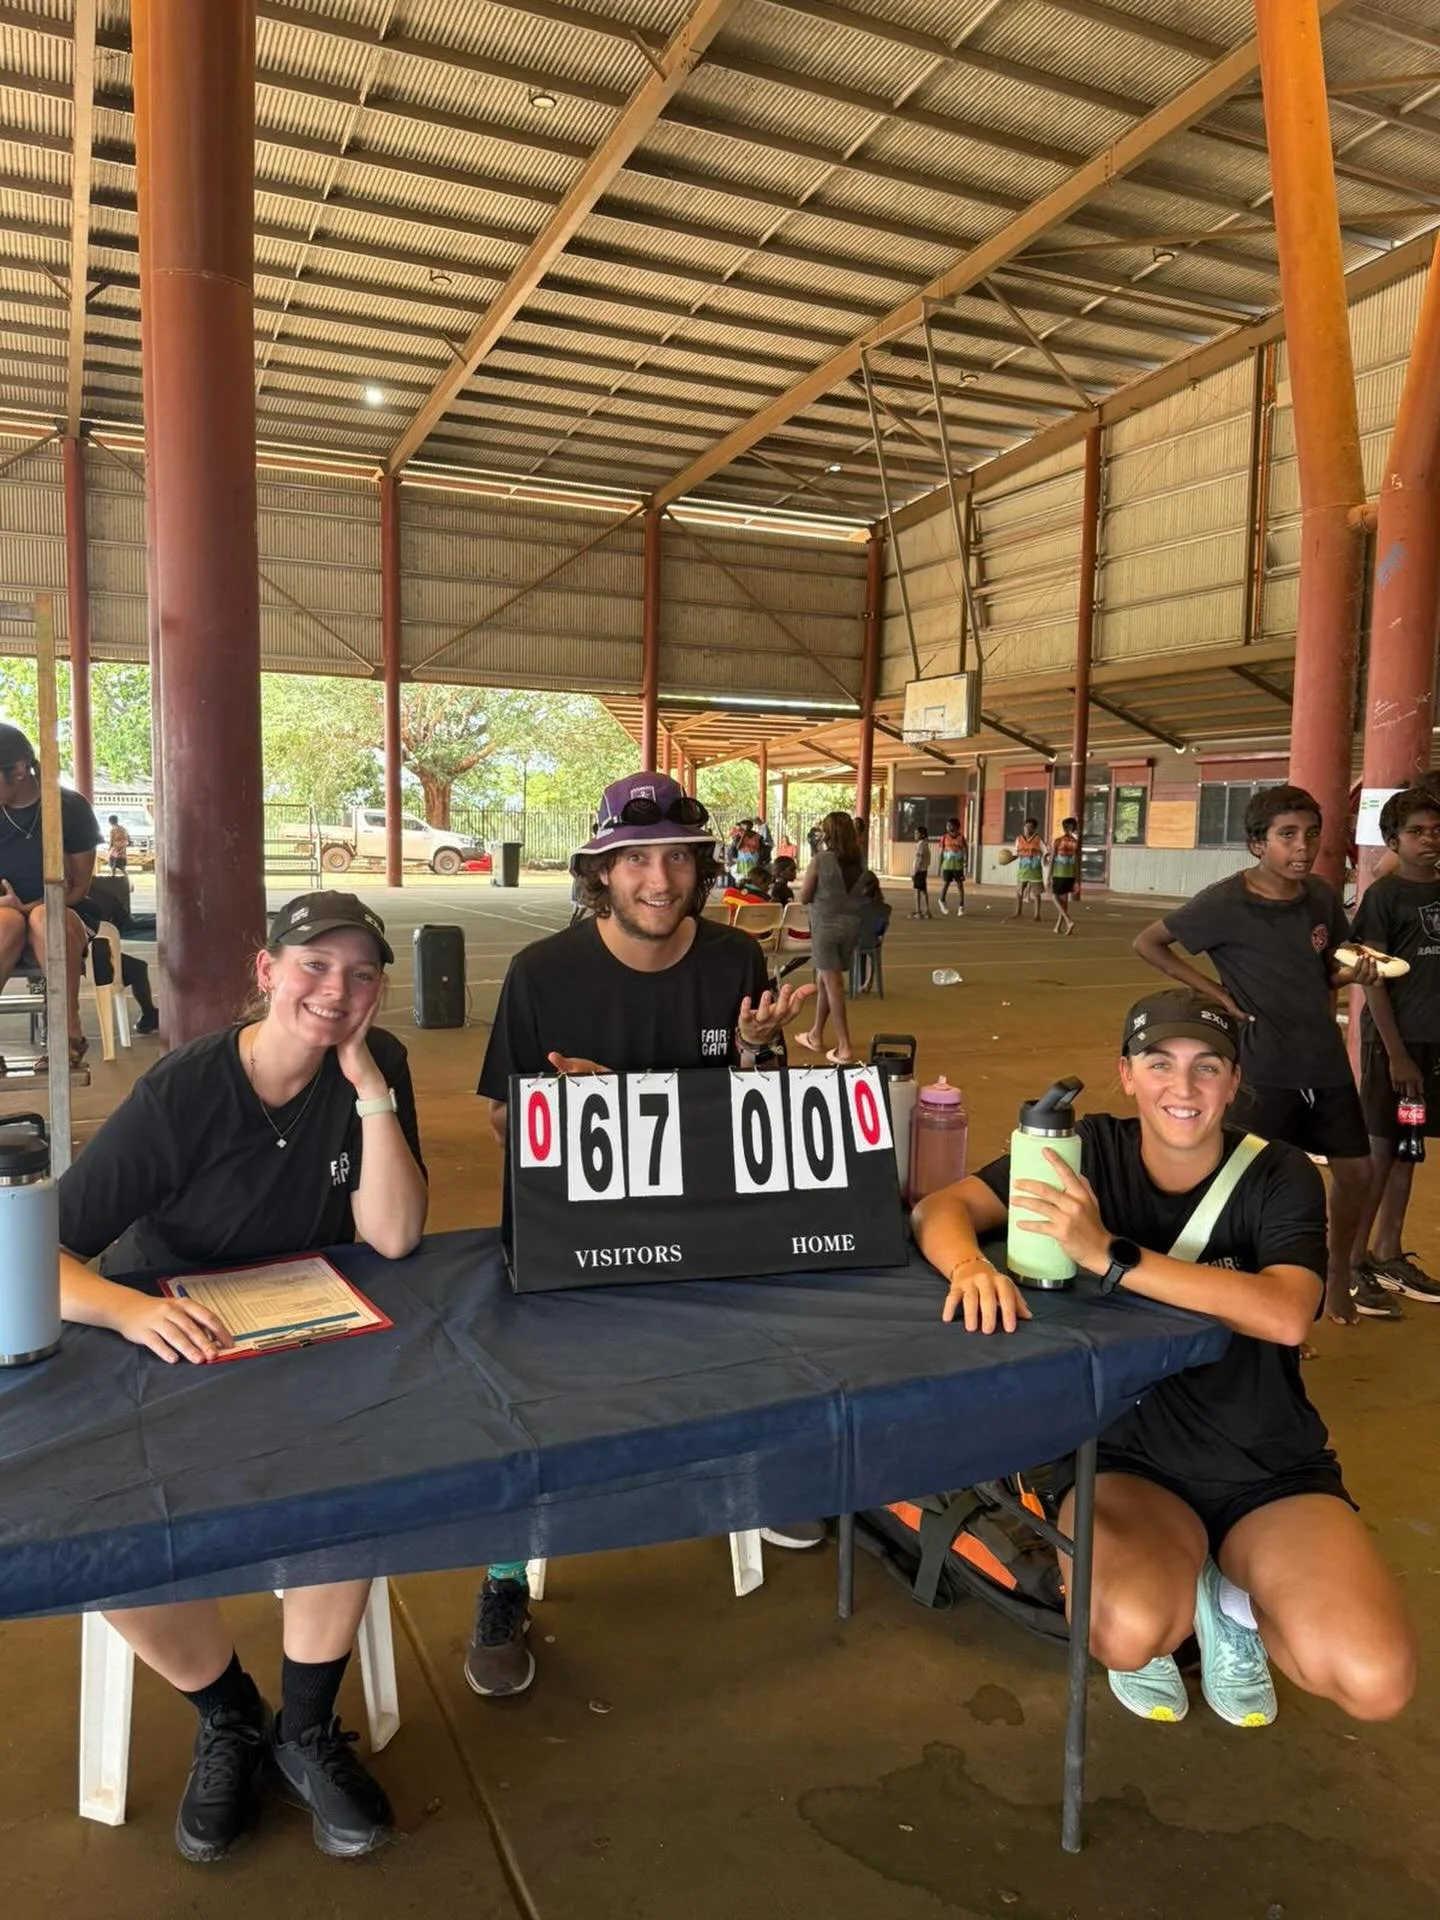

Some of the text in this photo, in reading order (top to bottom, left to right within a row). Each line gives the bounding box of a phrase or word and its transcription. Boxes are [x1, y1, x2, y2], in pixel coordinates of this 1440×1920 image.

[527, 1091, 551, 1161] 0
[854, 1079, 881, 1145] 0
[574, 1244, 683, 1268] VISITORS
[791, 1234, 856, 1255] HOME
